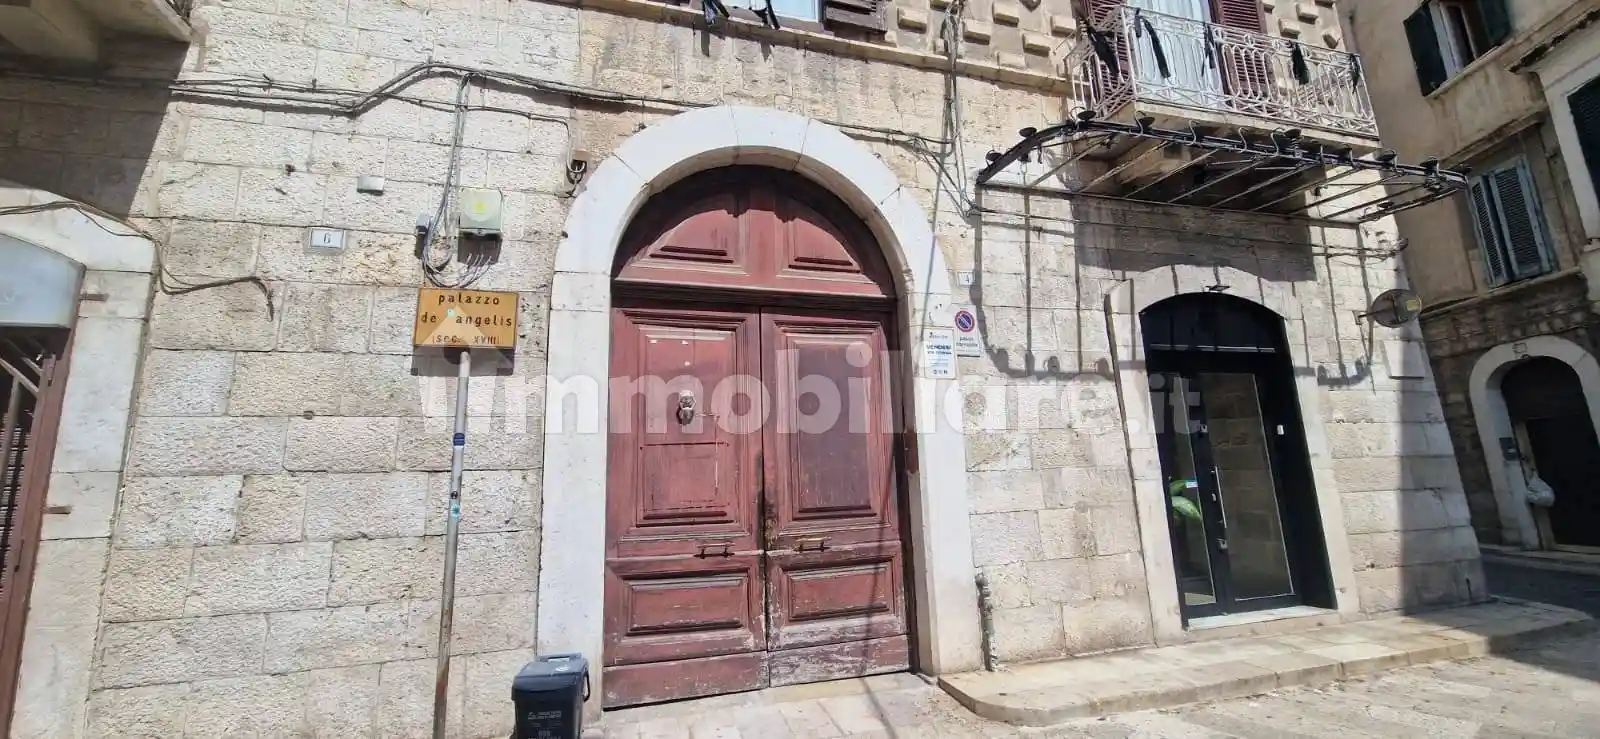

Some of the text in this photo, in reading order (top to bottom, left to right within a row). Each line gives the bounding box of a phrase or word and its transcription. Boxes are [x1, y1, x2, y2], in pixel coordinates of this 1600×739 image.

[438, 292, 500, 305] palazzo
[421, 312, 512, 327] de angelis
